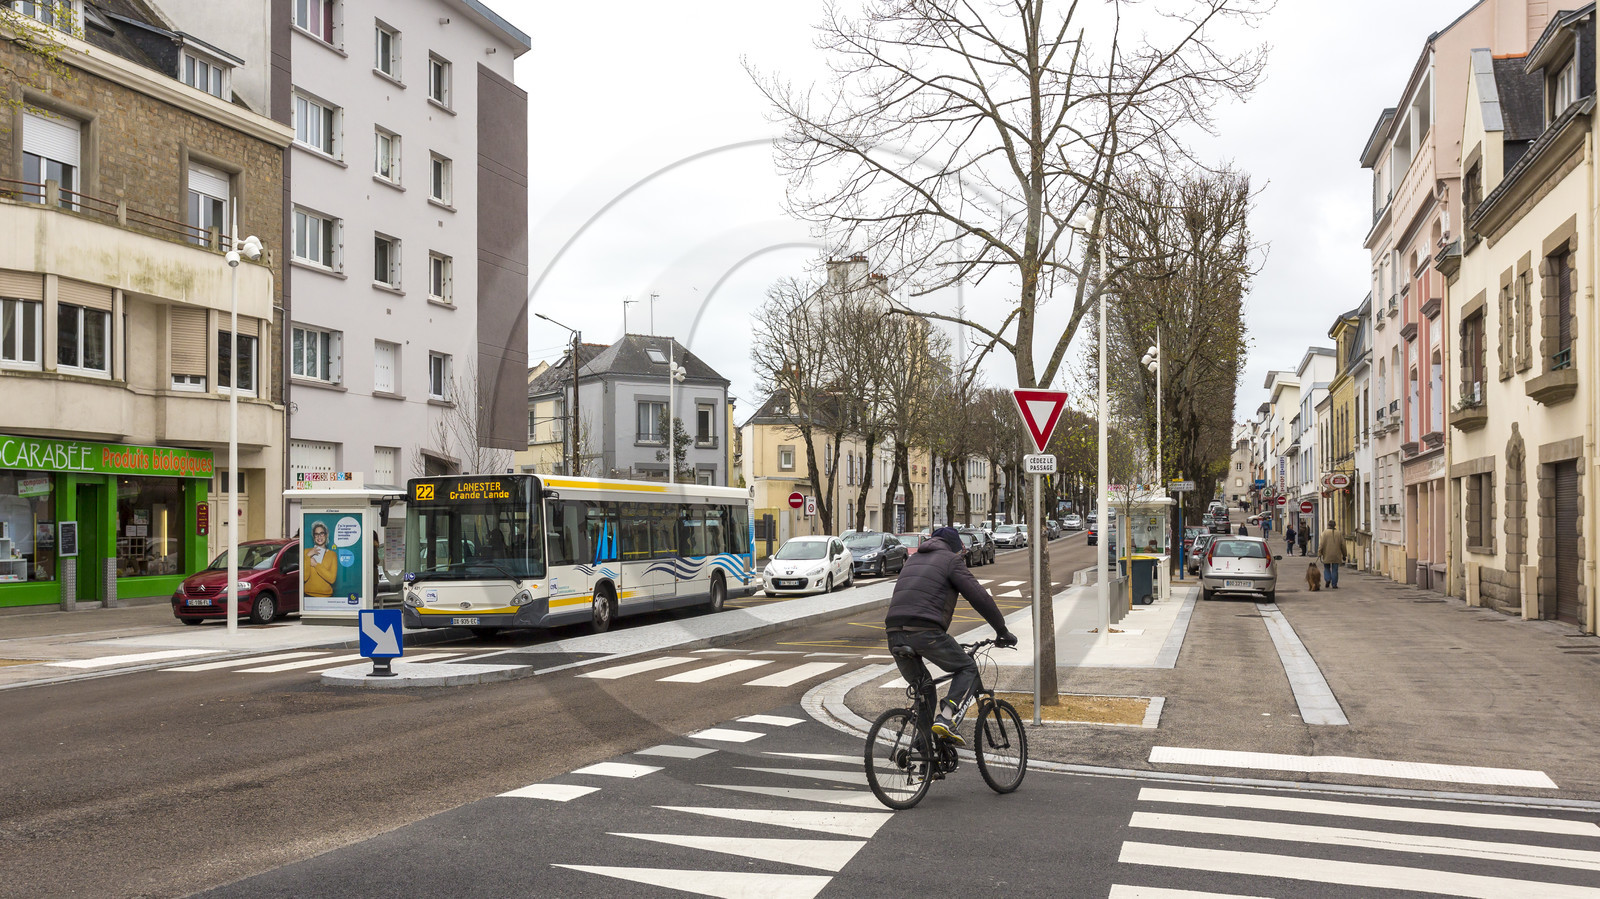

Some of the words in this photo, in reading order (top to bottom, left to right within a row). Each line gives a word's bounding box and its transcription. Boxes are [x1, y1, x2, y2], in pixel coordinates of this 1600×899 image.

[0, 440, 94, 471] CARABÉE
[102, 447, 149, 469] Produits
[152, 450, 213, 476] biologiques
[417, 485, 433, 499] 22
[458, 482, 501, 491] LANESTER
[450, 490, 480, 500] Grande
[483, 490, 509, 499] Lande
